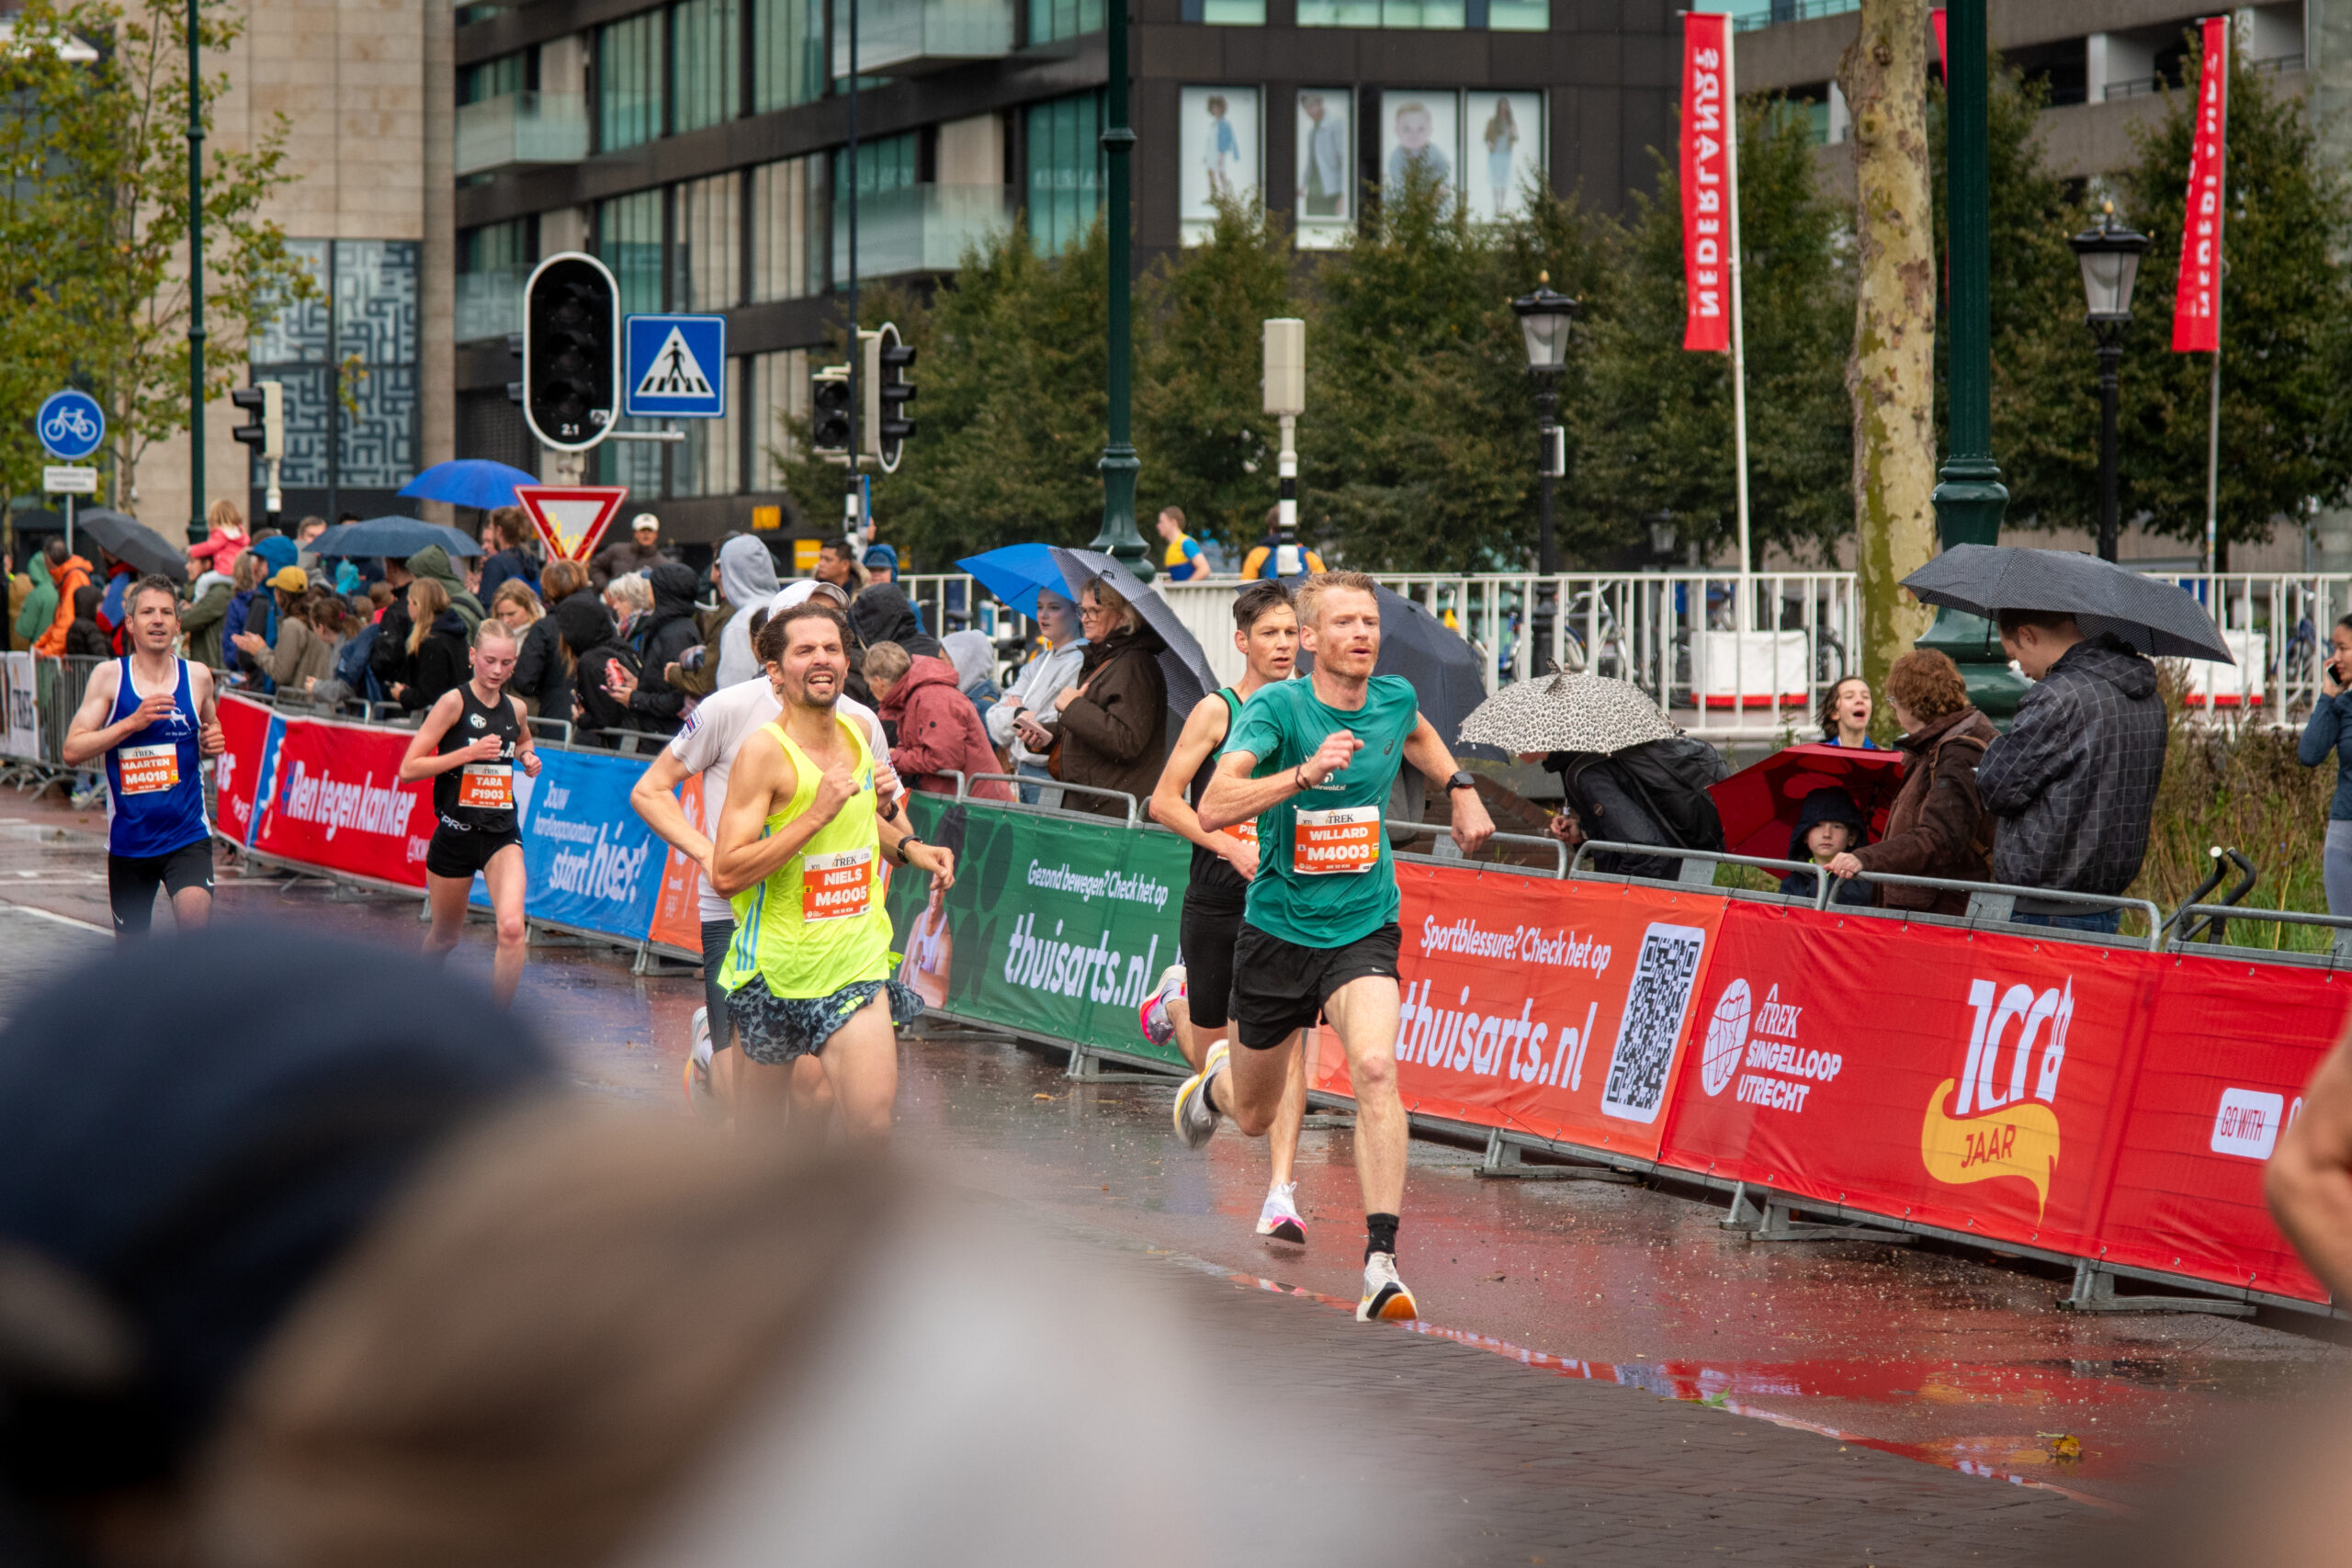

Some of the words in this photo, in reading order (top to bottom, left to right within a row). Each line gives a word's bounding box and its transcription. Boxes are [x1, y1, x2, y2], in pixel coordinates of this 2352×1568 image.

[121, 758, 170, 771] MAARTEN
[125, 770, 168, 784] M4018
[476, 777, 503, 786] TARA
[470, 788, 504, 800] F1903
[441, 814, 472, 831] PRO
[1329, 814, 1354, 824] TREK
[1238, 824, 1258, 836] PIE
[1309, 827, 1369, 841] WILLARD
[834, 855, 856, 868] TREK
[1307, 843, 1370, 862] M4003
[548, 846, 591, 896] start
[824, 868, 863, 886] NIELS
[1027, 859, 1066, 890] Gezond
[1062, 863, 1110, 902] bewegen?
[1107, 871, 1137, 901] Check
[1136, 874, 1156, 903] het
[1155, 886, 1169, 912] op
[815, 885, 867, 907] M4005
[1420, 914, 1524, 960] Sportblessure?
[1521, 927, 1564, 965] Check
[1564, 931, 1593, 968] het
[1591, 944, 1611, 979] op
[1004, 912, 1159, 1010] thuisarts.nl
[1756, 1001, 1804, 1039] TREK
[1396, 979, 1598, 1091] thuisarts.nl
[1746, 1039, 1842, 1082] SINGELLOOP
[1736, 1074, 1811, 1113] UTRECHT
[2221, 1105, 2238, 1137] GO
[2236, 1108, 2267, 1142] WITH
[1961, 1124, 2017, 1168] JAAR
